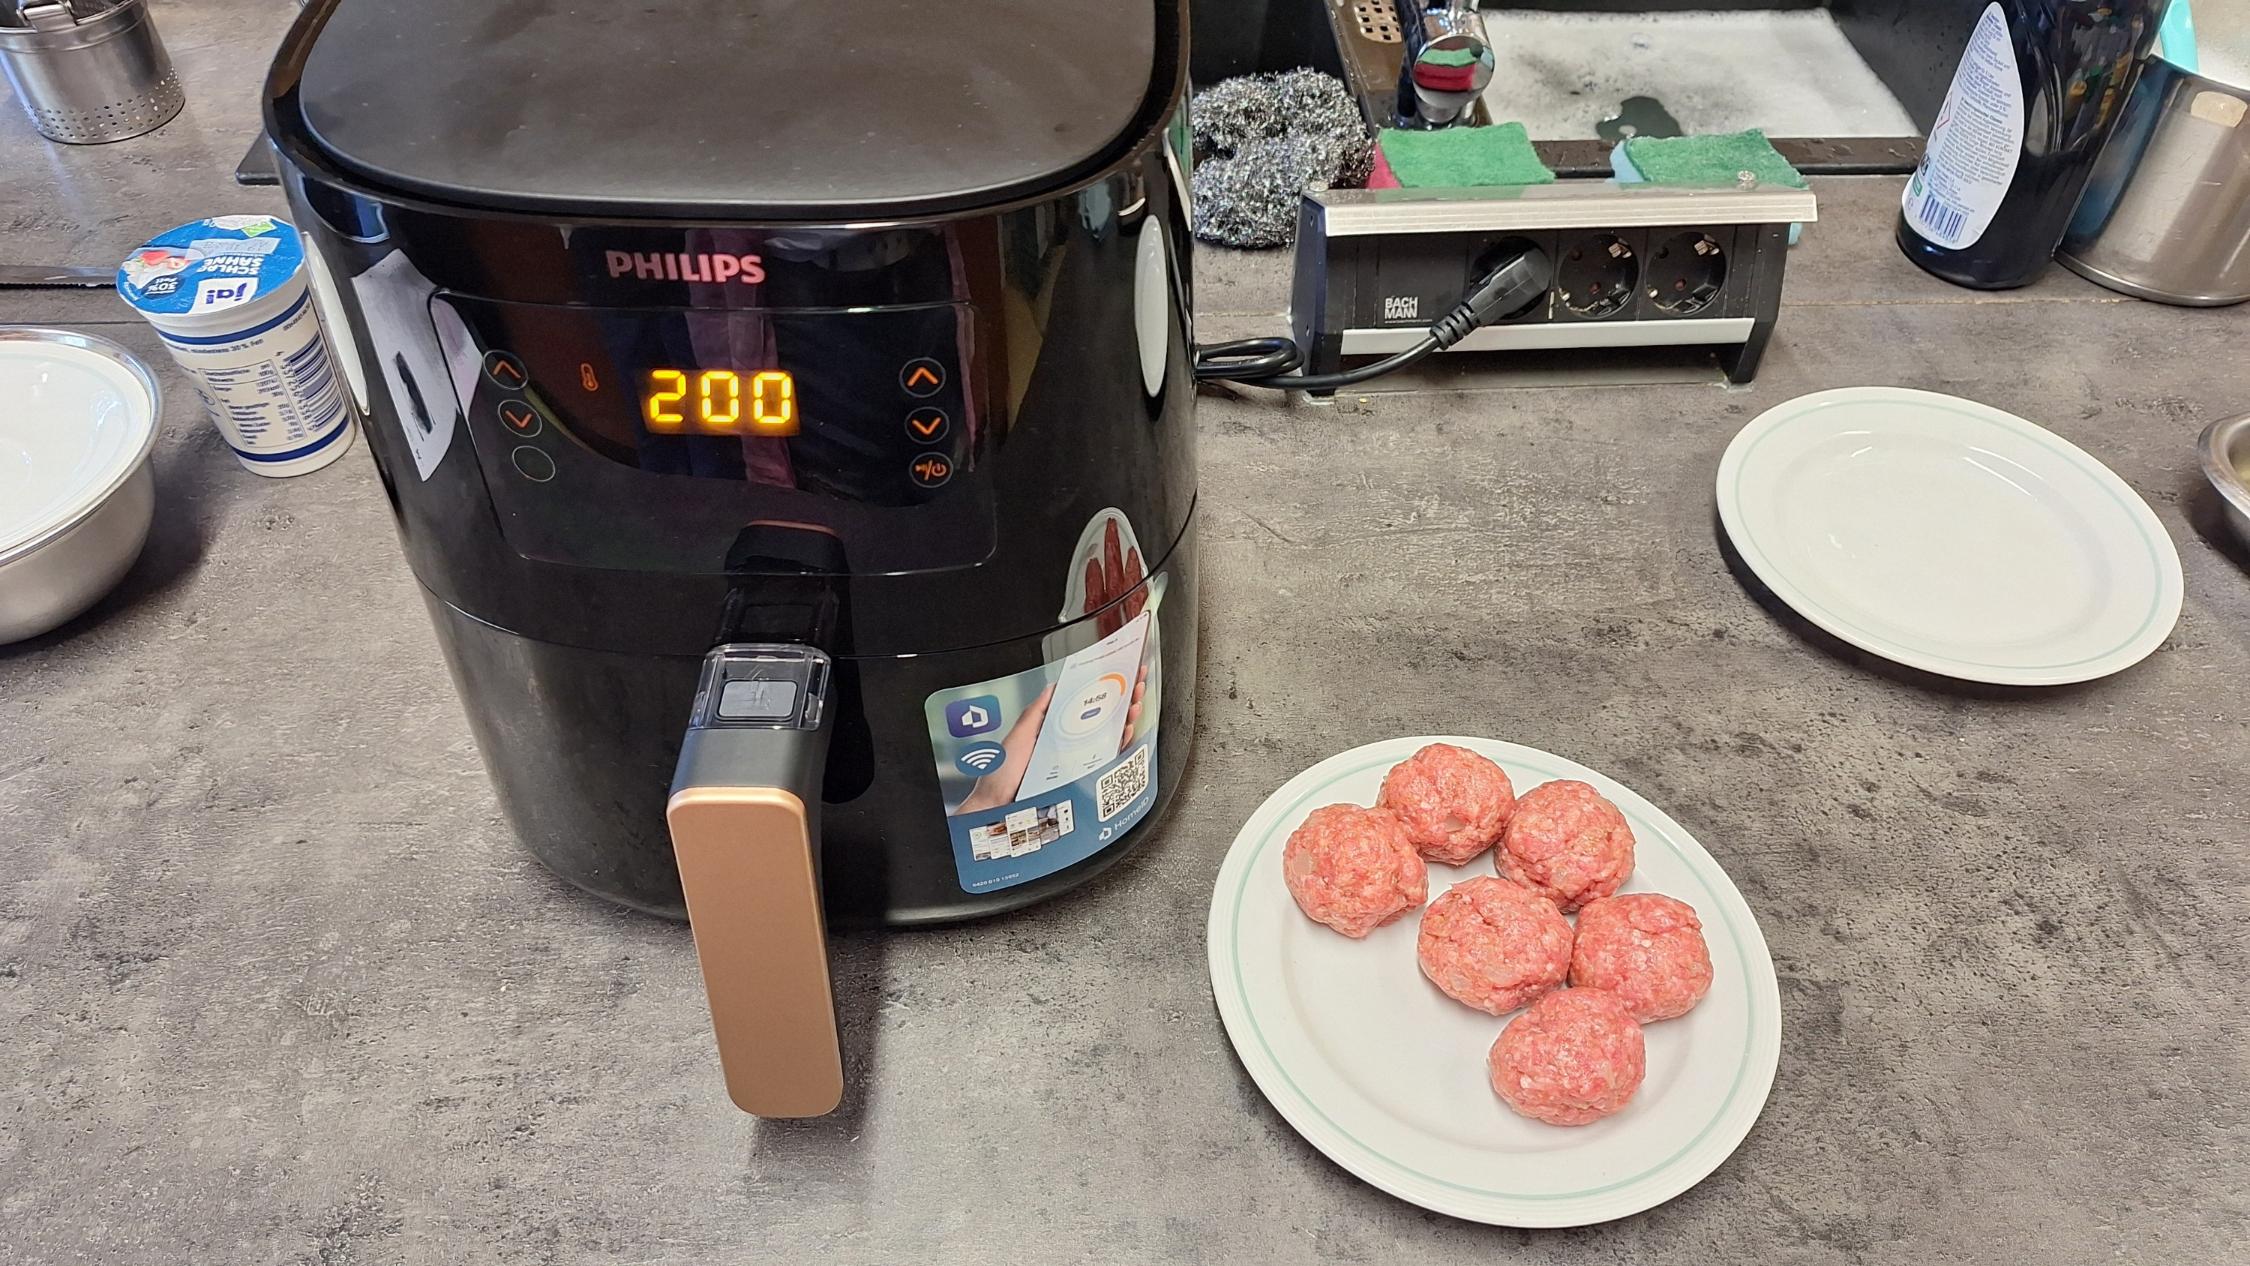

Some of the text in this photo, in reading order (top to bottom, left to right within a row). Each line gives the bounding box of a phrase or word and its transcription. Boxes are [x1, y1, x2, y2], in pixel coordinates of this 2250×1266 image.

[204, 255, 264, 268] SAHNE
[606, 250, 766, 284] PHILIPS
[205, 283, 248, 304] ja!
[1385, 297, 1418, 308] BACH
[1384, 307, 1418, 319] MANN
[649, 369, 792, 424] 200
